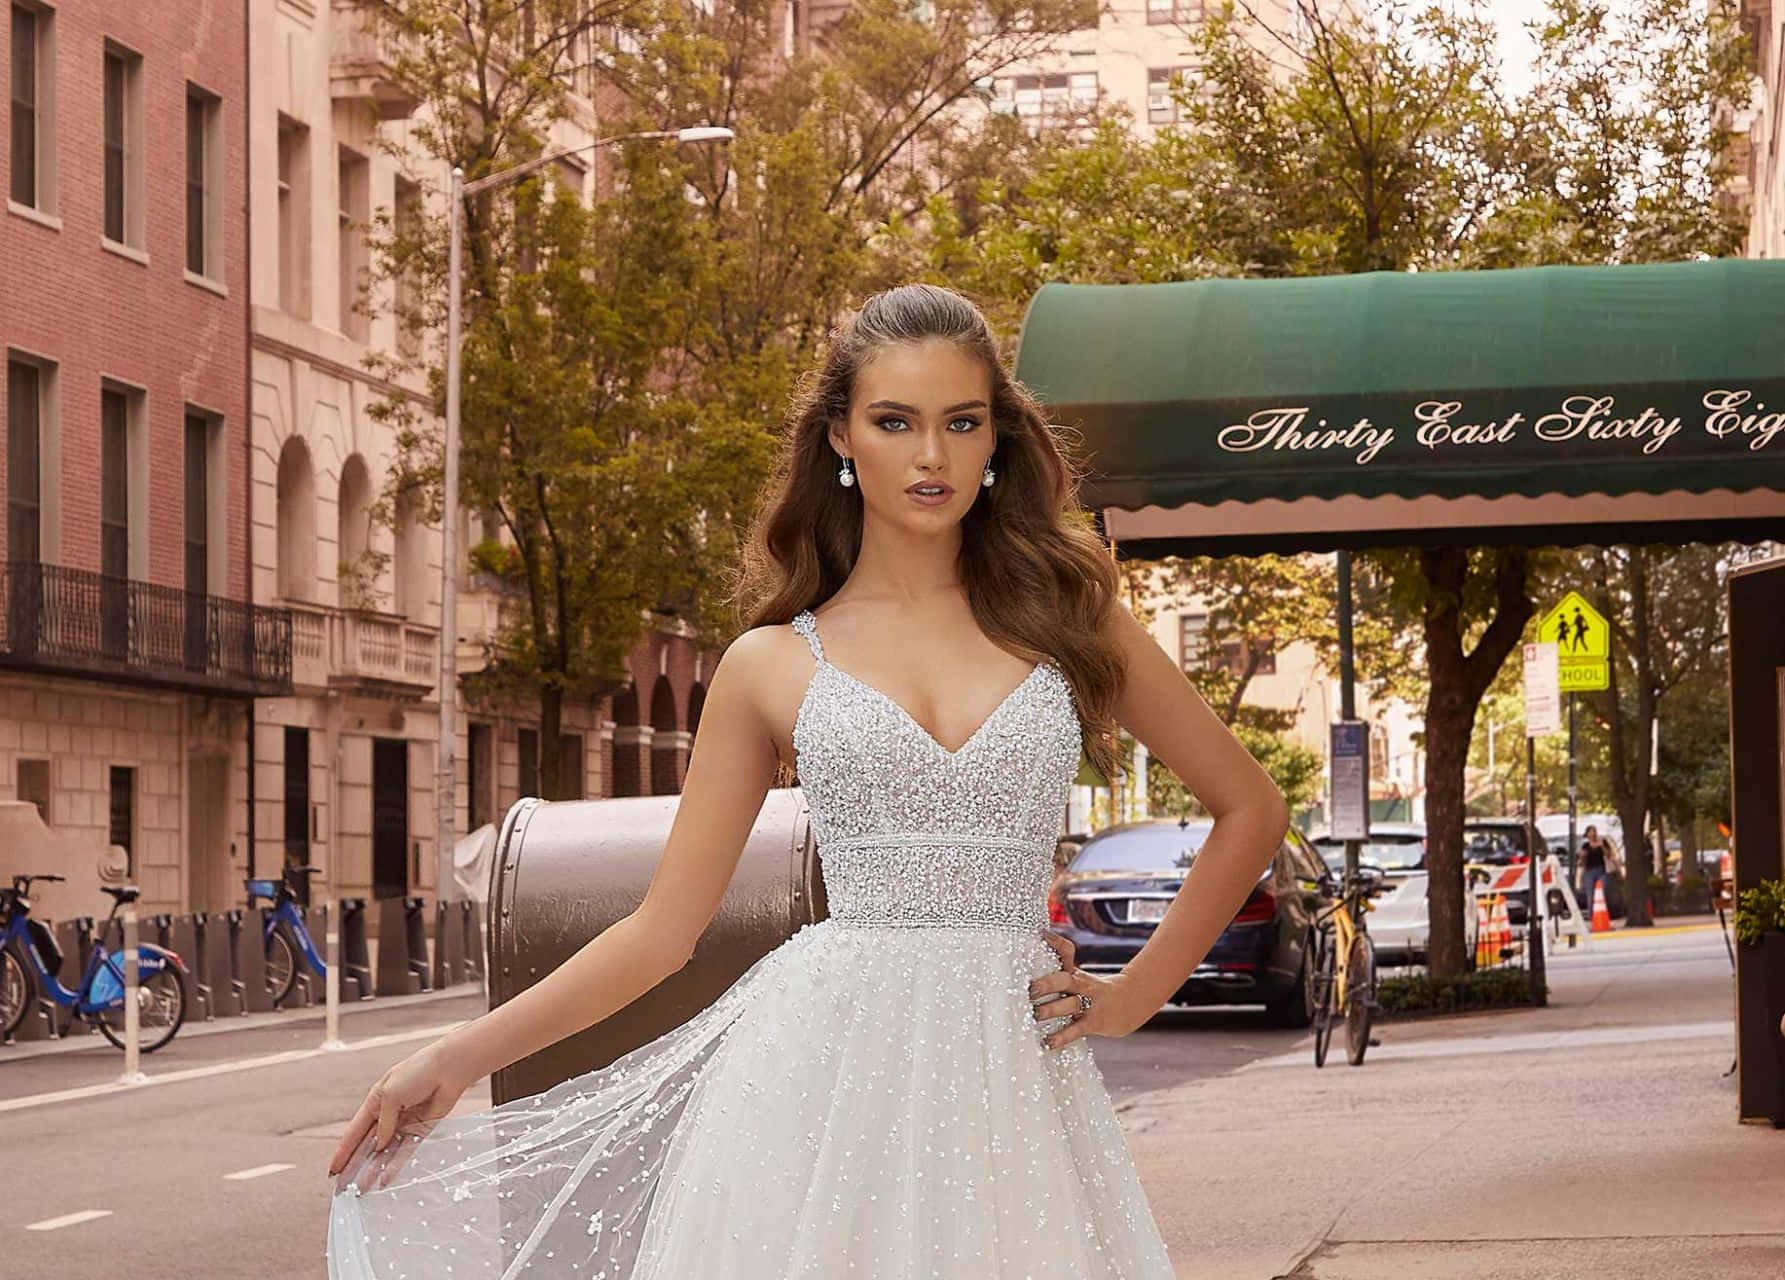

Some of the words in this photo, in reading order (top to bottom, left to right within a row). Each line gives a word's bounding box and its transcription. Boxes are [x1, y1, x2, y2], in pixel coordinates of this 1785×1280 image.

[1217, 407, 1395, 465] Thirty
[1414, 401, 1526, 450] East
[1534, 395, 1682, 454] Sixty
[1561, 668, 1602, 682] HOOL
